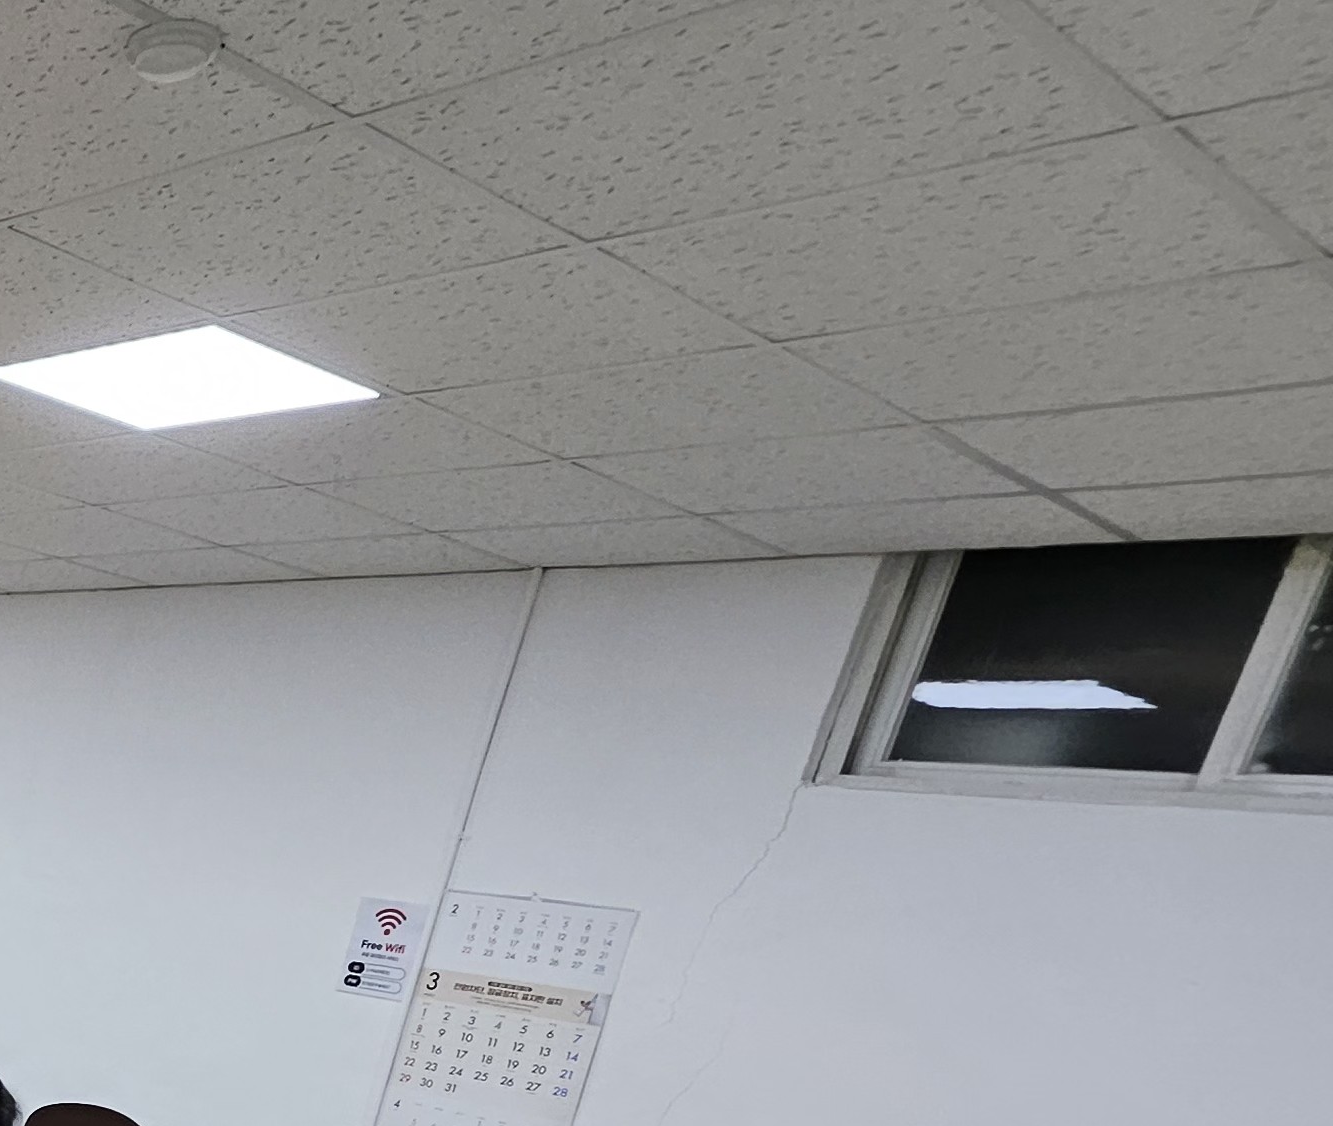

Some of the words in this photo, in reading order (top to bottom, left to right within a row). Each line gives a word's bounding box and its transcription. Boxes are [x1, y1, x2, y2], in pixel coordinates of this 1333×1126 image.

[451, 904, 459, 915] 2
[361, 940, 383, 950] Free
[385, 943, 406, 954] Wifi
[426, 972, 440, 990] 3
[422, 1008, 427, 1017] 1
[443, 1012, 451, 1021] 2
[468, 1016, 476, 1026] 3
[494, 1021, 502, 1030] 4
[519, 1025, 528, 1034] 5
[546, 1030, 554, 1039] 6
[573, 1034, 583, 1043] 7
[416, 1024, 422, 1033] 8
[438, 1028, 446, 1037] 9
[461, 1032, 473, 1042] 10
[488, 1037, 498, 1047] 11
[512, 1042, 525, 1052] 12
[539, 1046, 551, 1057] 13
[566, 1051, 580, 1062] 14
[410, 1040, 419, 1050] 15
[431, 1044, 442, 1055] 16
[456, 1049, 468, 1059] 17
[481, 1054, 493, 1064] 18
[507, 1059, 520, 1069] 19
[531, 1064, 547, 1075] 20
[559, 1069, 574, 1080] 21
[399, 1073, 411, 1083] 29
[420, 1078, 433, 1088] 30
[445, 1083, 457, 1092] 31
[404, 1056, 416, 1067] 22
[424, 1061, 438, 1072] 23
[449, 1066, 463, 1076] 24
[474, 1071, 489, 1082] 25
[500, 1076, 514, 1087] 26
[525, 1081, 541, 1092] 27
[552, 1086, 569, 1098] 28
